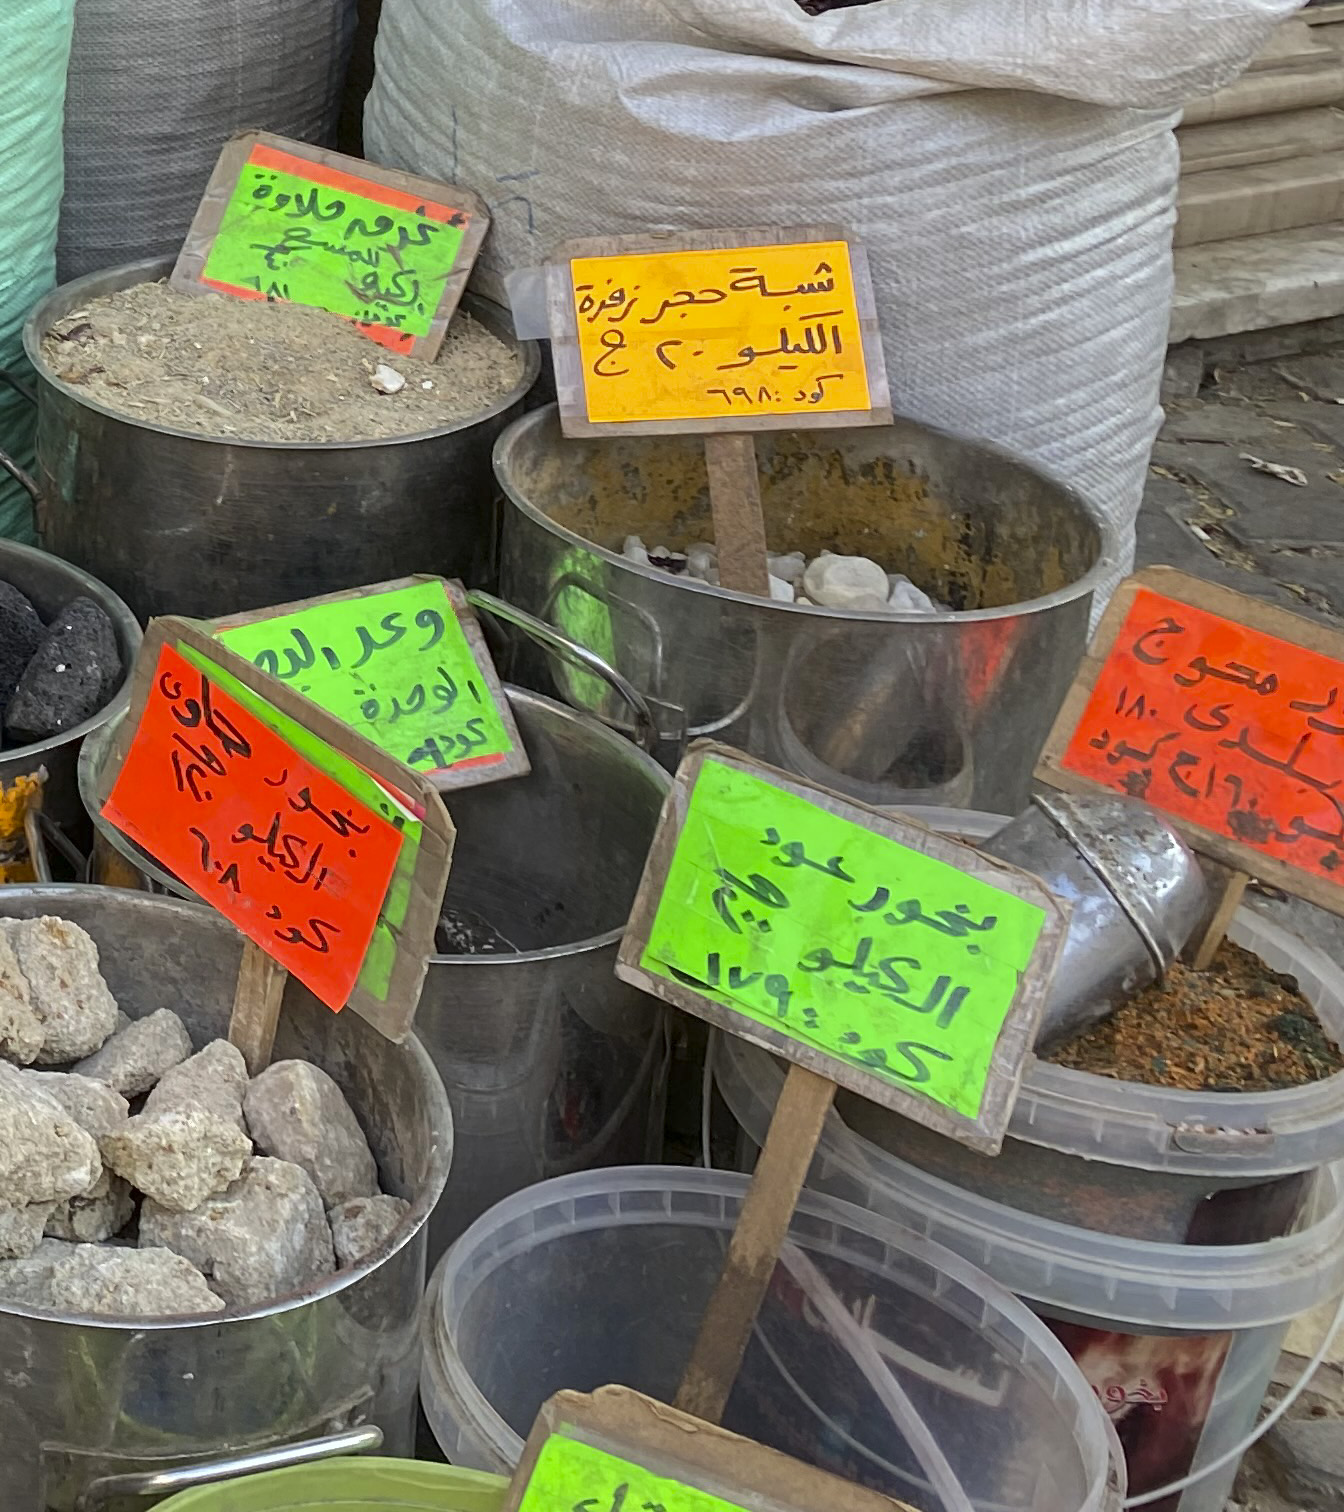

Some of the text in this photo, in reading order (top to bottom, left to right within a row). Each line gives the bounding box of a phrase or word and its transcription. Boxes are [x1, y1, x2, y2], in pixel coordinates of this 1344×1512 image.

[639, 287, 728, 325] حجر
[1132, 616, 1279, 696] محوج
[230, 811, 329, 891] الكيلو
[263, 768, 372, 859] بخور
[758, 825, 999, 956] بخور عود
[796, 936, 972, 1031] الكيلو
